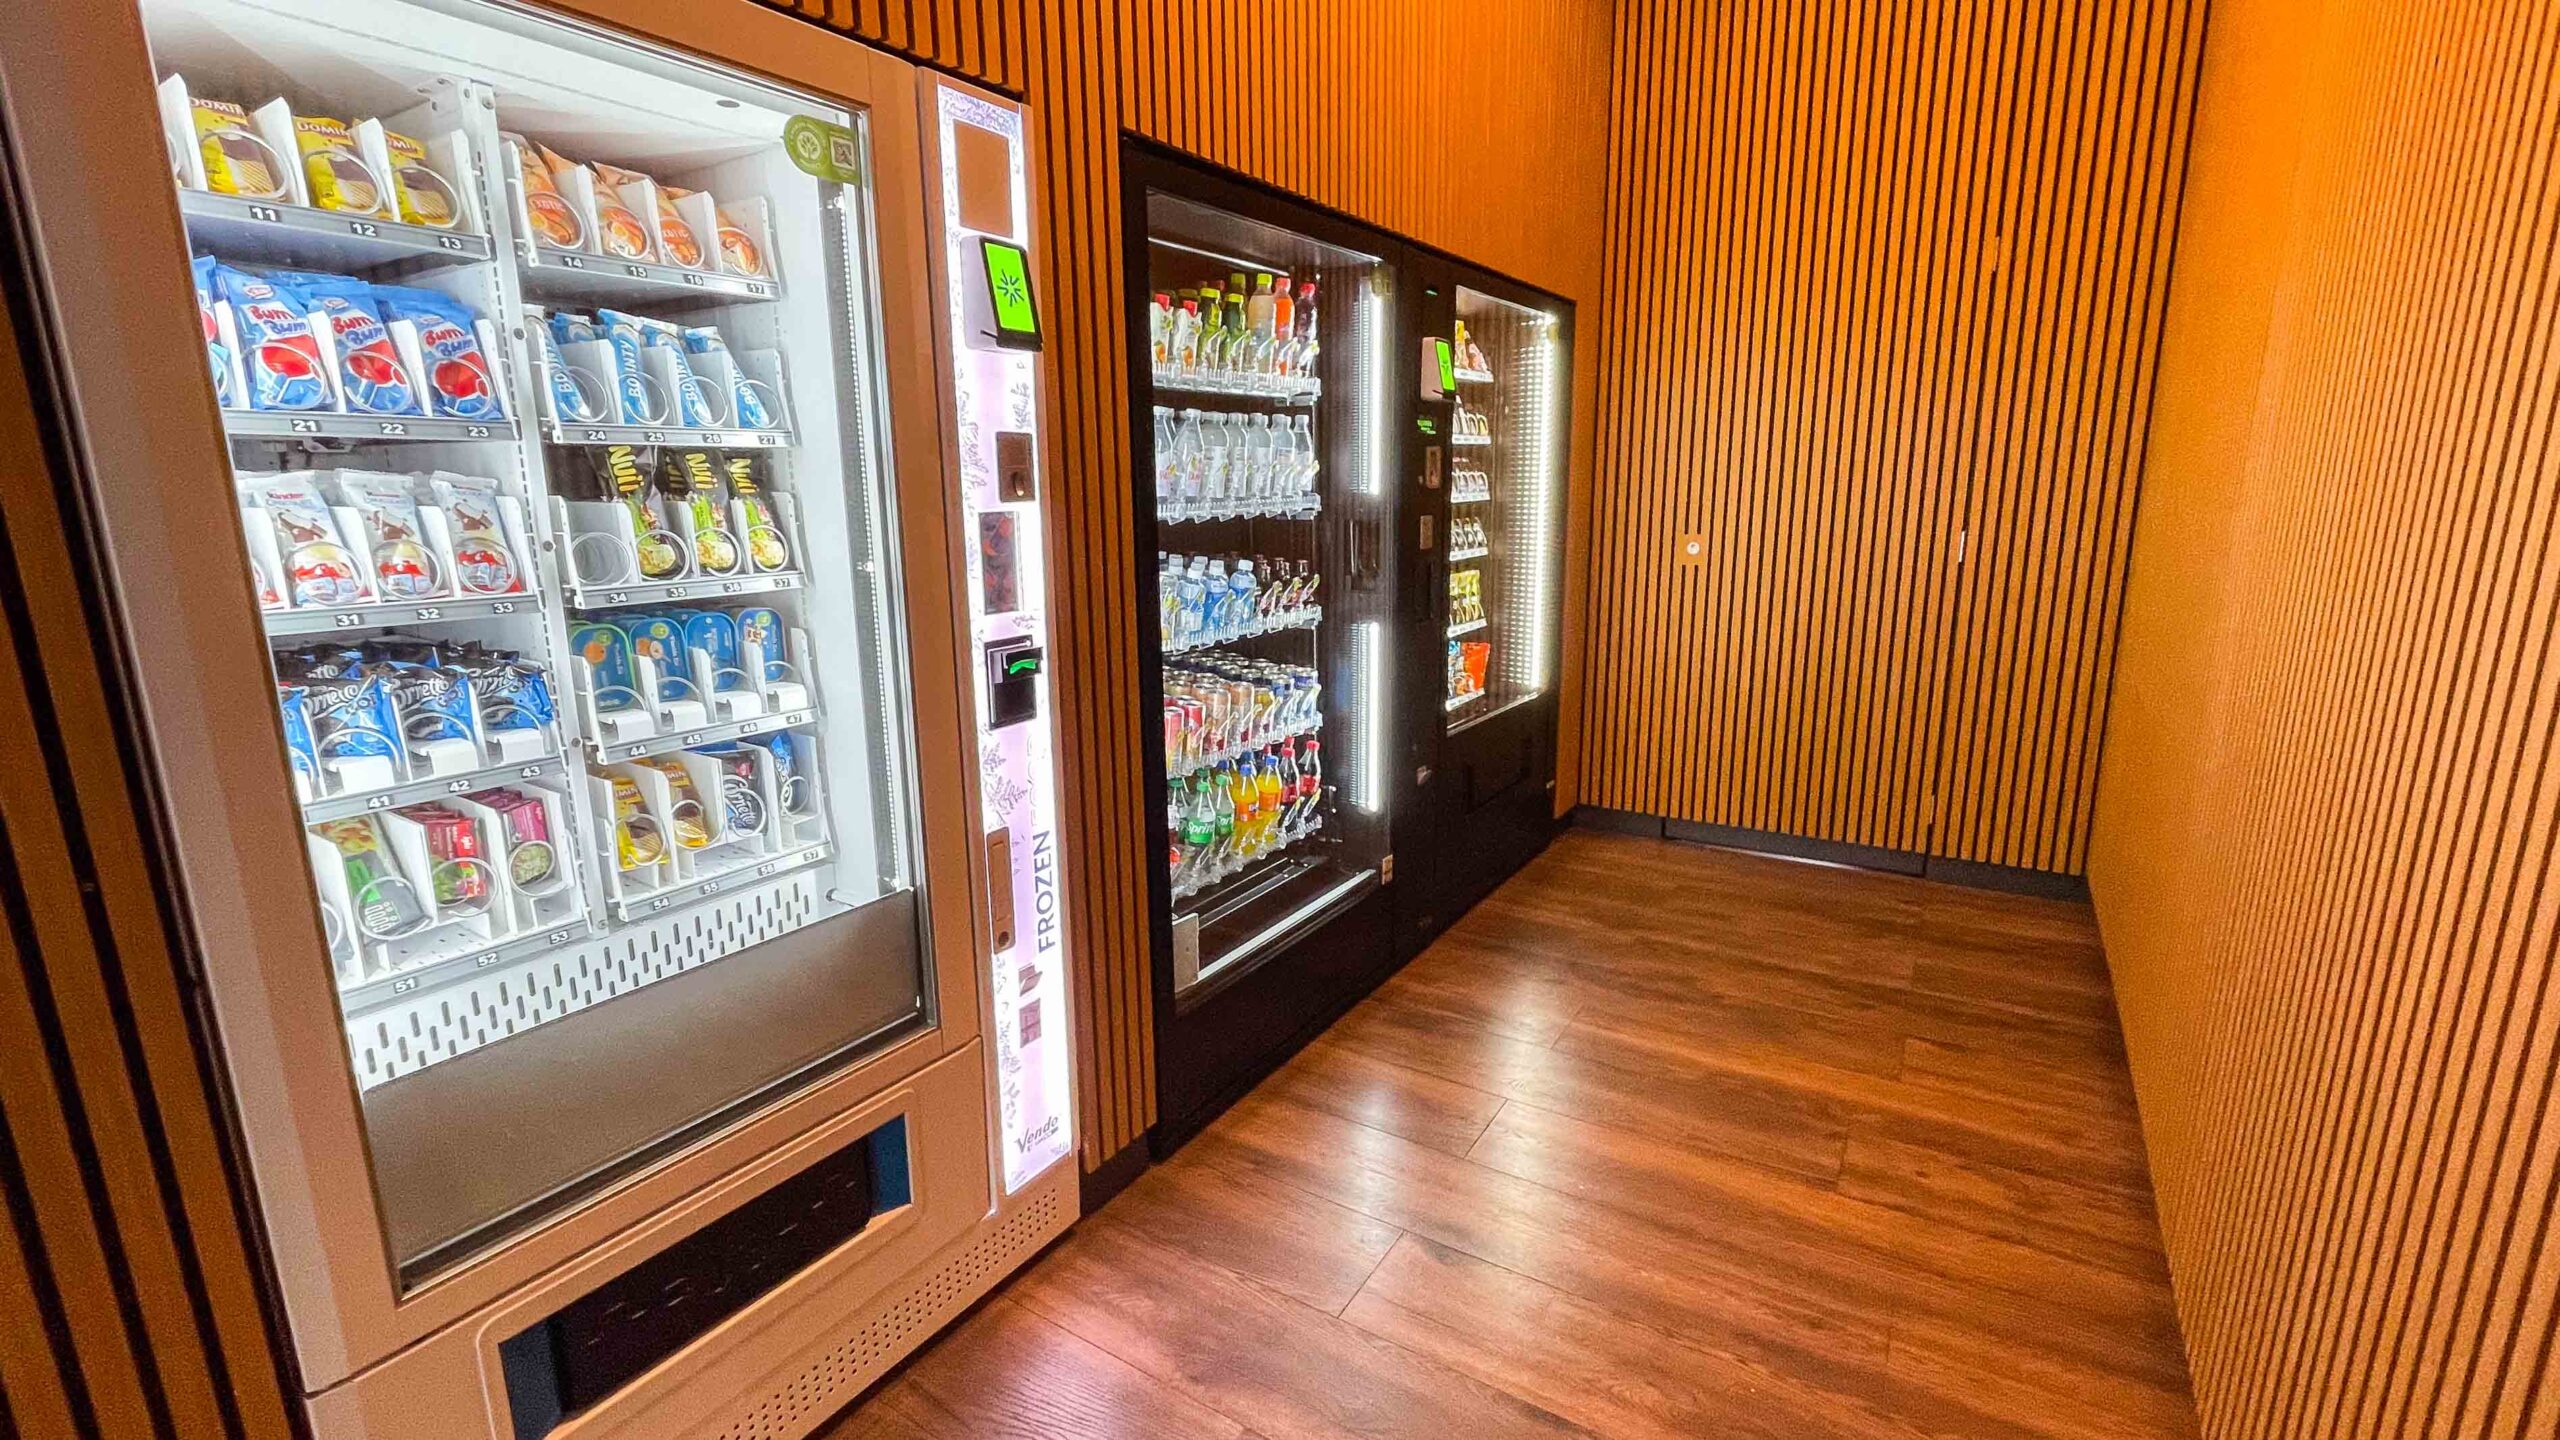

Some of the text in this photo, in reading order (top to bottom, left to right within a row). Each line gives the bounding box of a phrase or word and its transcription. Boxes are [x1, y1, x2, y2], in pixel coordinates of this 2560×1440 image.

[252, 207, 462, 249] 11 12 13
[564, 257, 764, 293] 14 15 16 17
[248, 305, 297, 320] Bum
[263, 320, 306, 335] Bum
[331, 315, 376, 335] Bum
[345, 326, 384, 346] Bum
[424, 328, 466, 347] Bum
[435, 339, 474, 357] Bum
[293, 420, 489, 437] 21 22 23
[588, 431, 775, 444] 24 25 26 27
[610, 578, 789, 603] 34 35 36 37
[337, 603, 513, 626] 31 32 33
[630, 745, 646, 755] 44
[686, 735, 701, 744] 45
[369, 766, 540, 808] 41 42 43
[654, 899, 669, 909] 54
[704, 883, 718, 893] 55
[761, 864, 774, 874] 56
[1033, 830, 1056, 954] FROZEN
[395, 931, 569, 992] 51 52 53
[1014, 1116, 1059, 1154] Vendo
